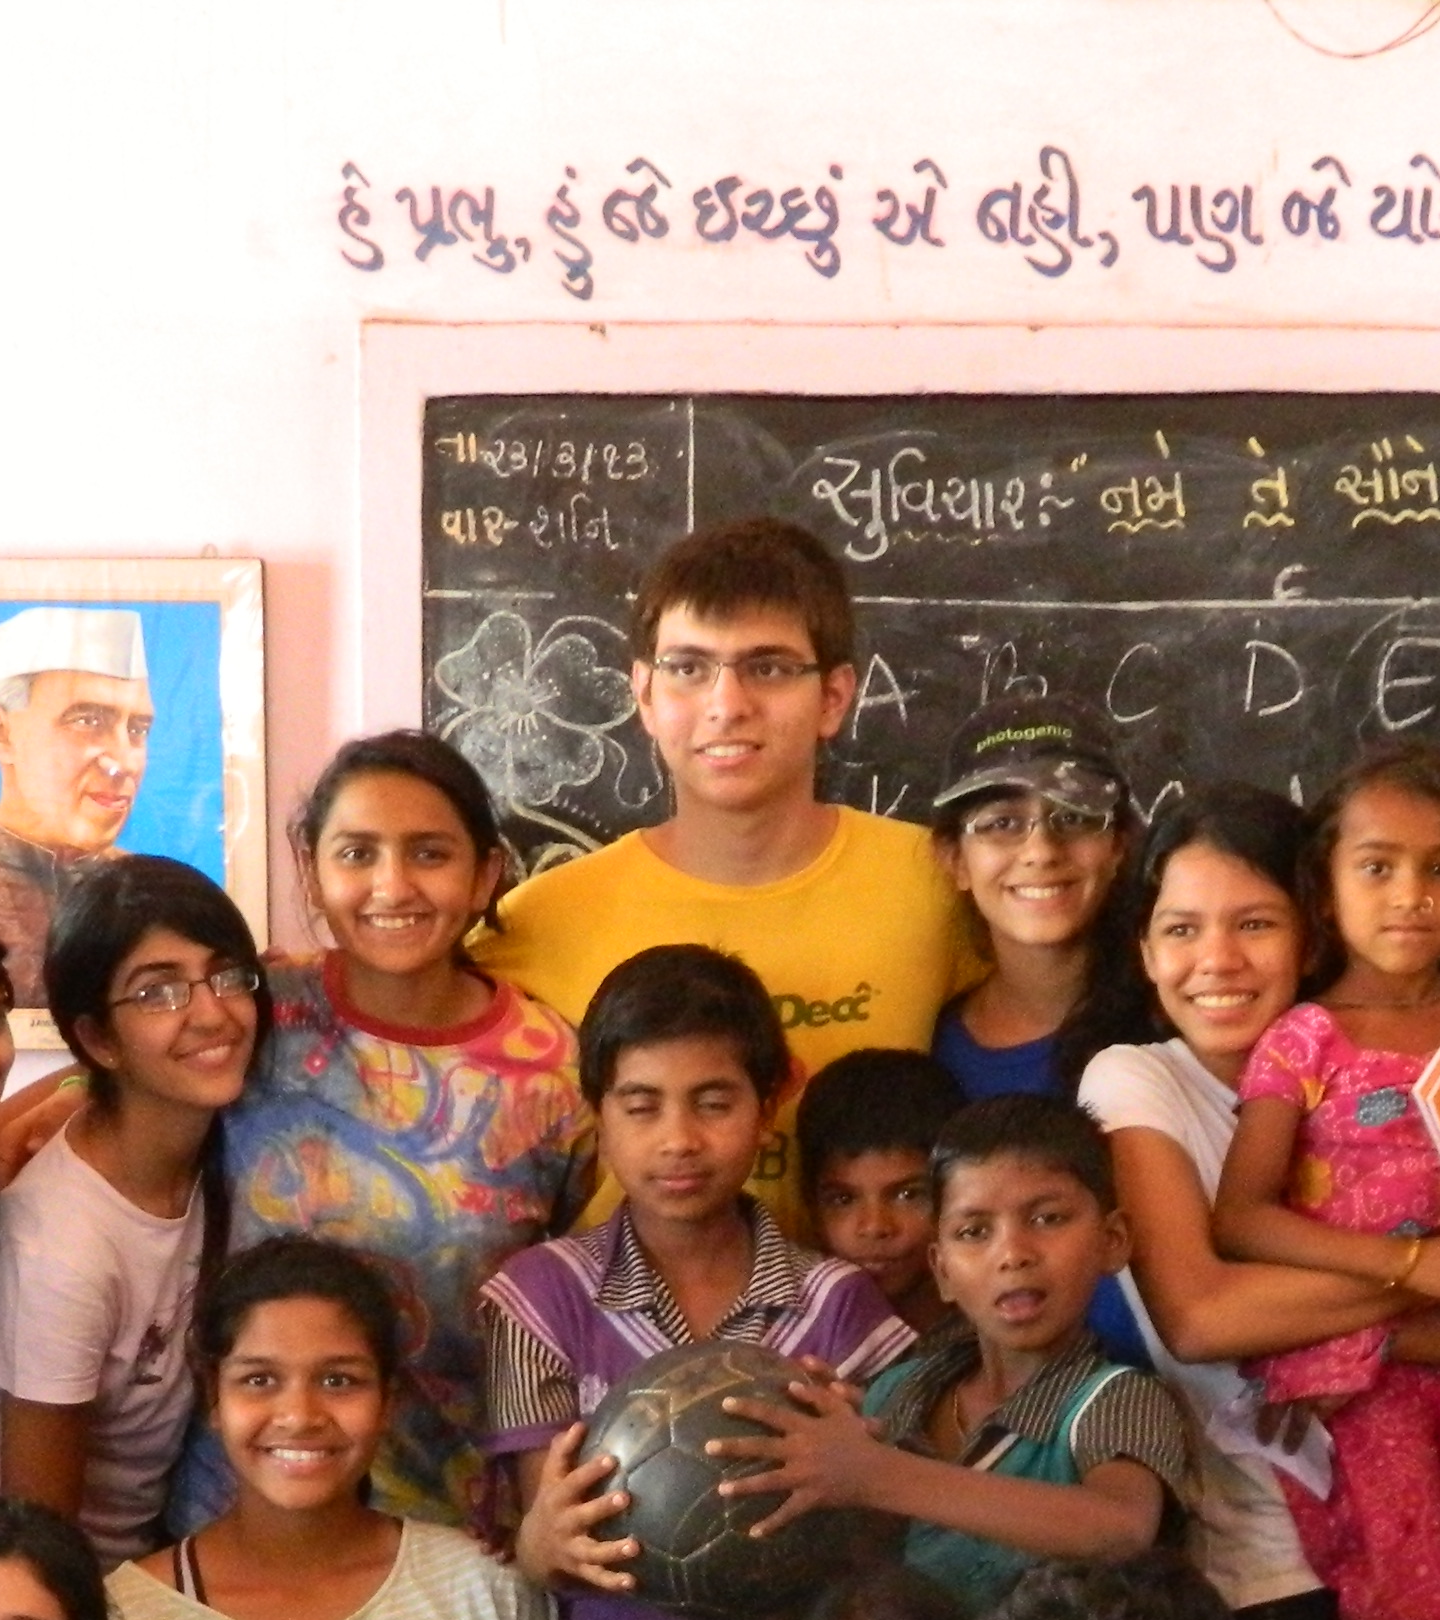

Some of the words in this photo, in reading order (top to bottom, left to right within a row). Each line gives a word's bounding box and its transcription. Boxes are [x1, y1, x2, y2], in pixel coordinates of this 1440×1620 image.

[1132, 185, 1265, 274] પણ
[852, 652, 920, 740] A
[1106, 642, 1159, 723] C
[1244, 640, 1305, 717] D
